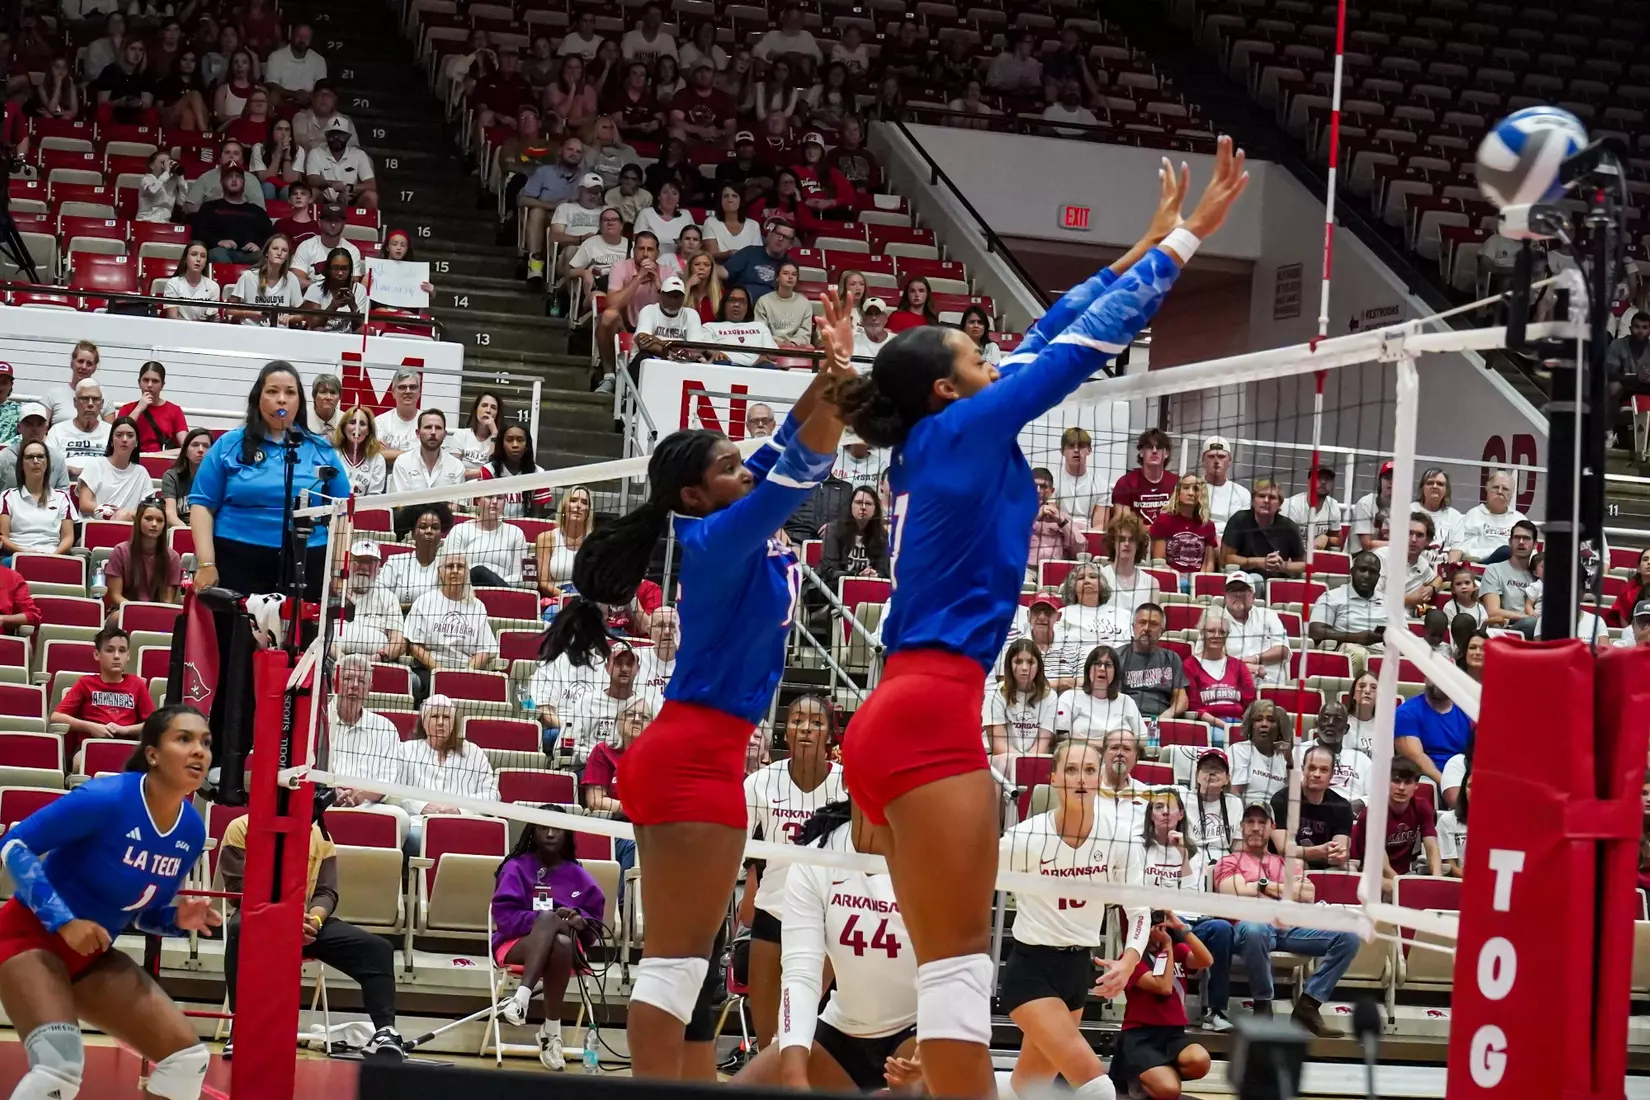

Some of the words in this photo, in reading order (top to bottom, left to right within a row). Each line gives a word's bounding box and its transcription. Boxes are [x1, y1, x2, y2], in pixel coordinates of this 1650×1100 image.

[341, 69, 354, 79] 21
[353, 98, 370, 108] 20
[372, 128, 386, 139] 19
[385, 158, 399, 169] 18
[400, 191, 414, 202] 17
[1066, 206, 1091, 228] EXIT
[417, 226, 431, 237] 16
[435, 262, 449, 273] 15
[453, 296, 468, 307] 14
[475, 333, 490, 345] 13
[340, 352, 424, 417] M
[517, 410, 529, 422] 11
[680, 380, 748, 442] N
[1608, 504, 1619, 516] 11
[433, 622, 454, 634] PARTY
[92, 691, 135, 709] ARKANSAS
[772, 808, 816, 818] ARKAN
[123, 846, 148, 870] LA
[151, 854, 181, 876] TECH
[1144, 867, 1182, 878] ARKANS
[831, 893, 900, 913] ARKANSA
[840, 914, 901, 958] 44
